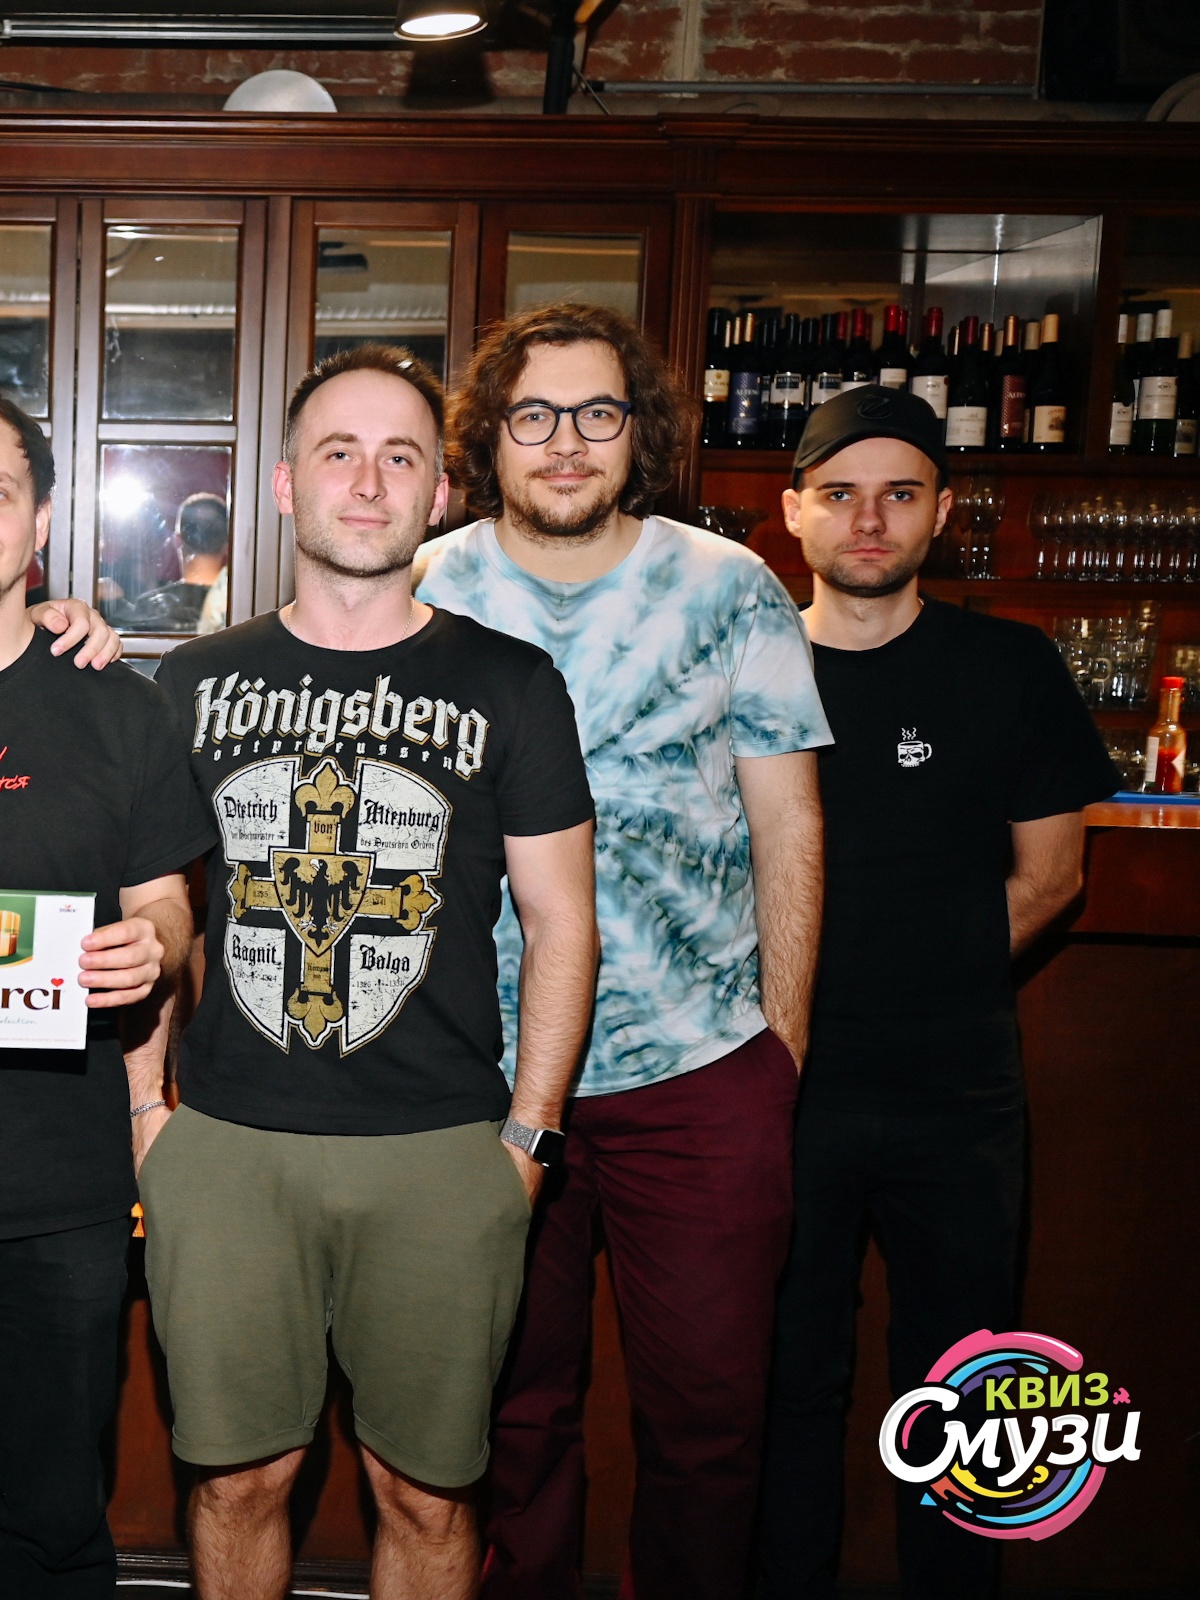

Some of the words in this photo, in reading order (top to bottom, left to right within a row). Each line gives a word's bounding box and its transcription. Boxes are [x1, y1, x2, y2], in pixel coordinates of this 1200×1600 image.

[192, 671, 490, 780] Königsberg
[223, 796, 278, 823] Dietrich
[363, 799, 440, 832] Altenburg
[374, 837, 409, 849] Deutschen
[232, 934, 280, 966] Ragnit
[359, 944, 411, 975] Balga
